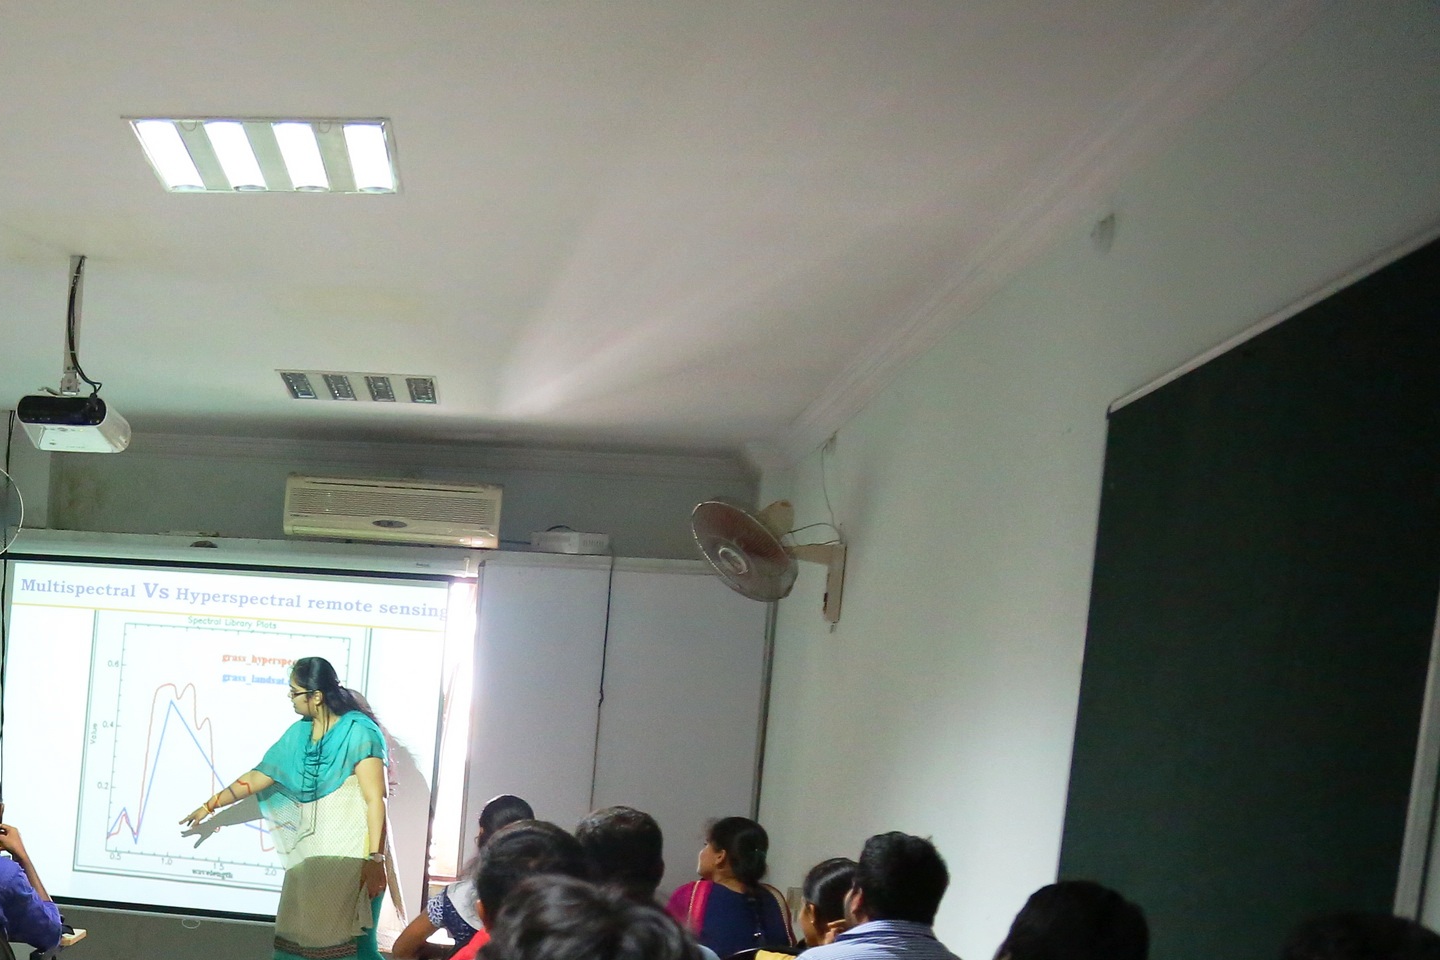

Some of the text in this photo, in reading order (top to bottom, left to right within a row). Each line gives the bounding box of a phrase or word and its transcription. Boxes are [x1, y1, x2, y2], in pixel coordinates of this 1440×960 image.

[21, 578, 136, 598] Multispectral
[143, 582, 170, 599] Vs
[176, 587, 301, 608] Hyperspectral
[308, 598, 372, 613] remote
[188, 616, 277, 630] Spectral Library Plots
